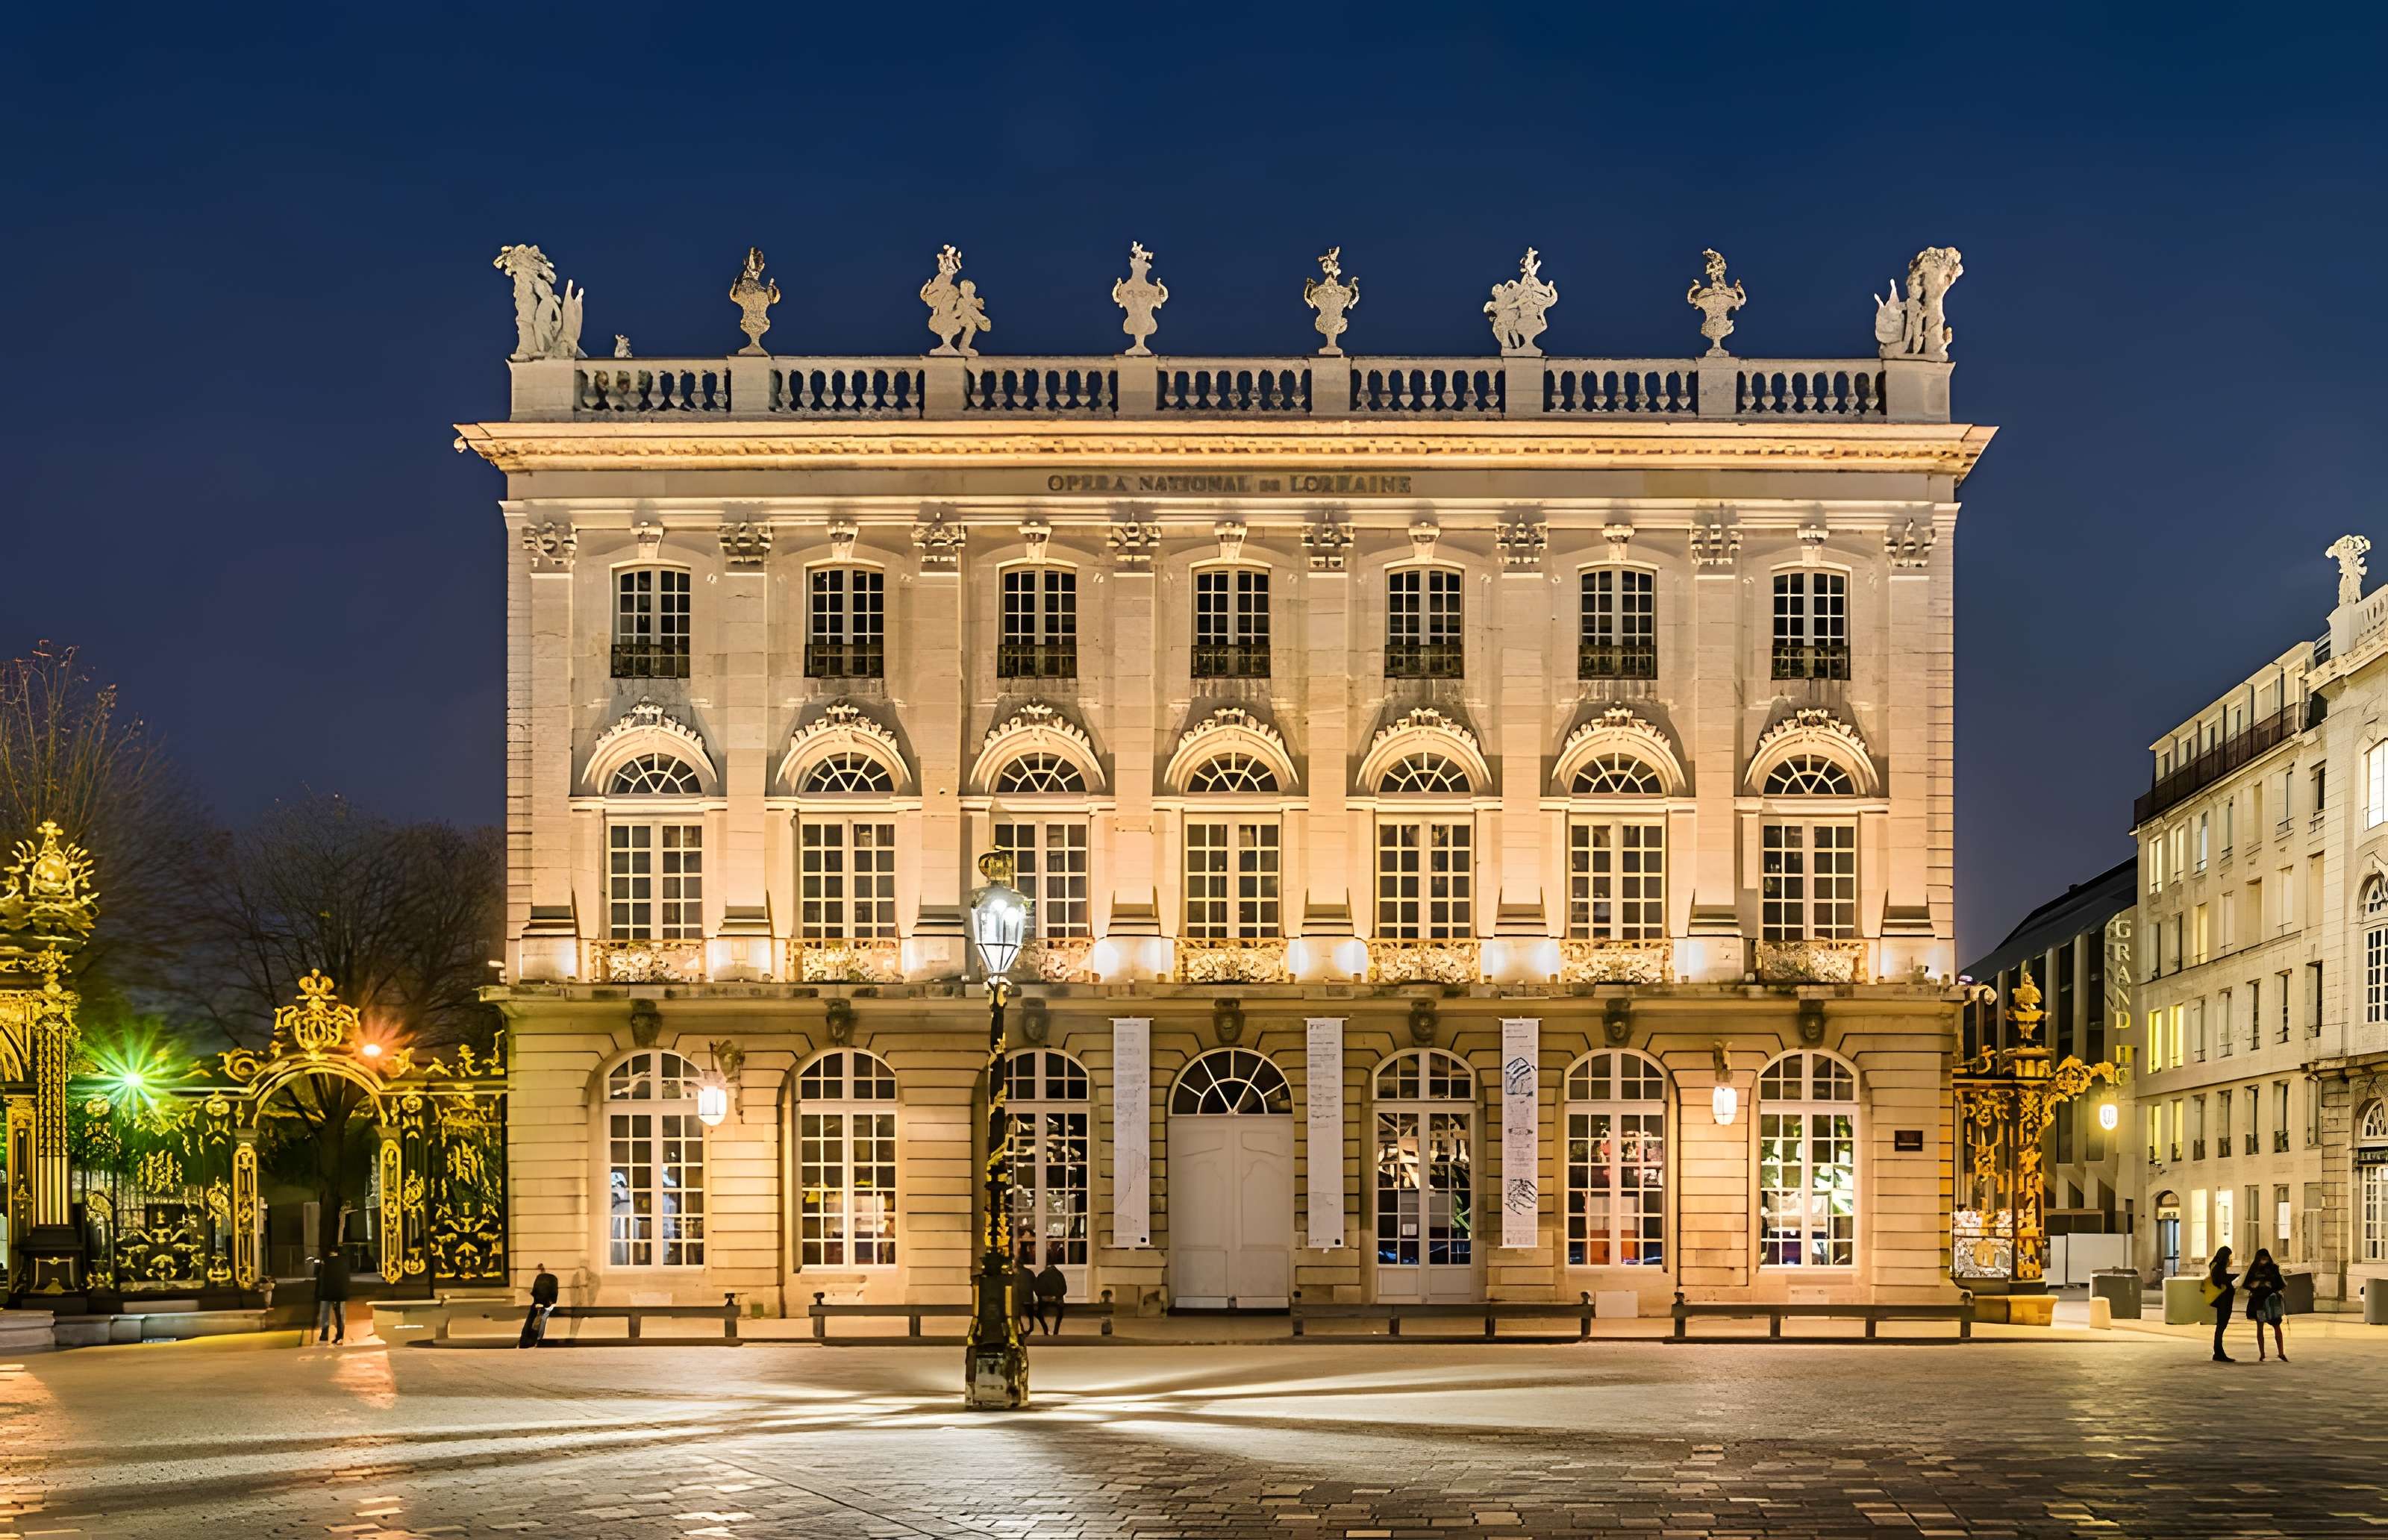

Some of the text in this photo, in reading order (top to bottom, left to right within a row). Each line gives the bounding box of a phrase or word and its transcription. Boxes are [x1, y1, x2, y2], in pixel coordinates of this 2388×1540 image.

[1047, 475, 1128, 491] OPERA
[1140, 475, 1251, 492] NATIONAL
[1290, 475, 1411, 493] LORRAINE
[2114, 919, 2131, 1029] GRAND
